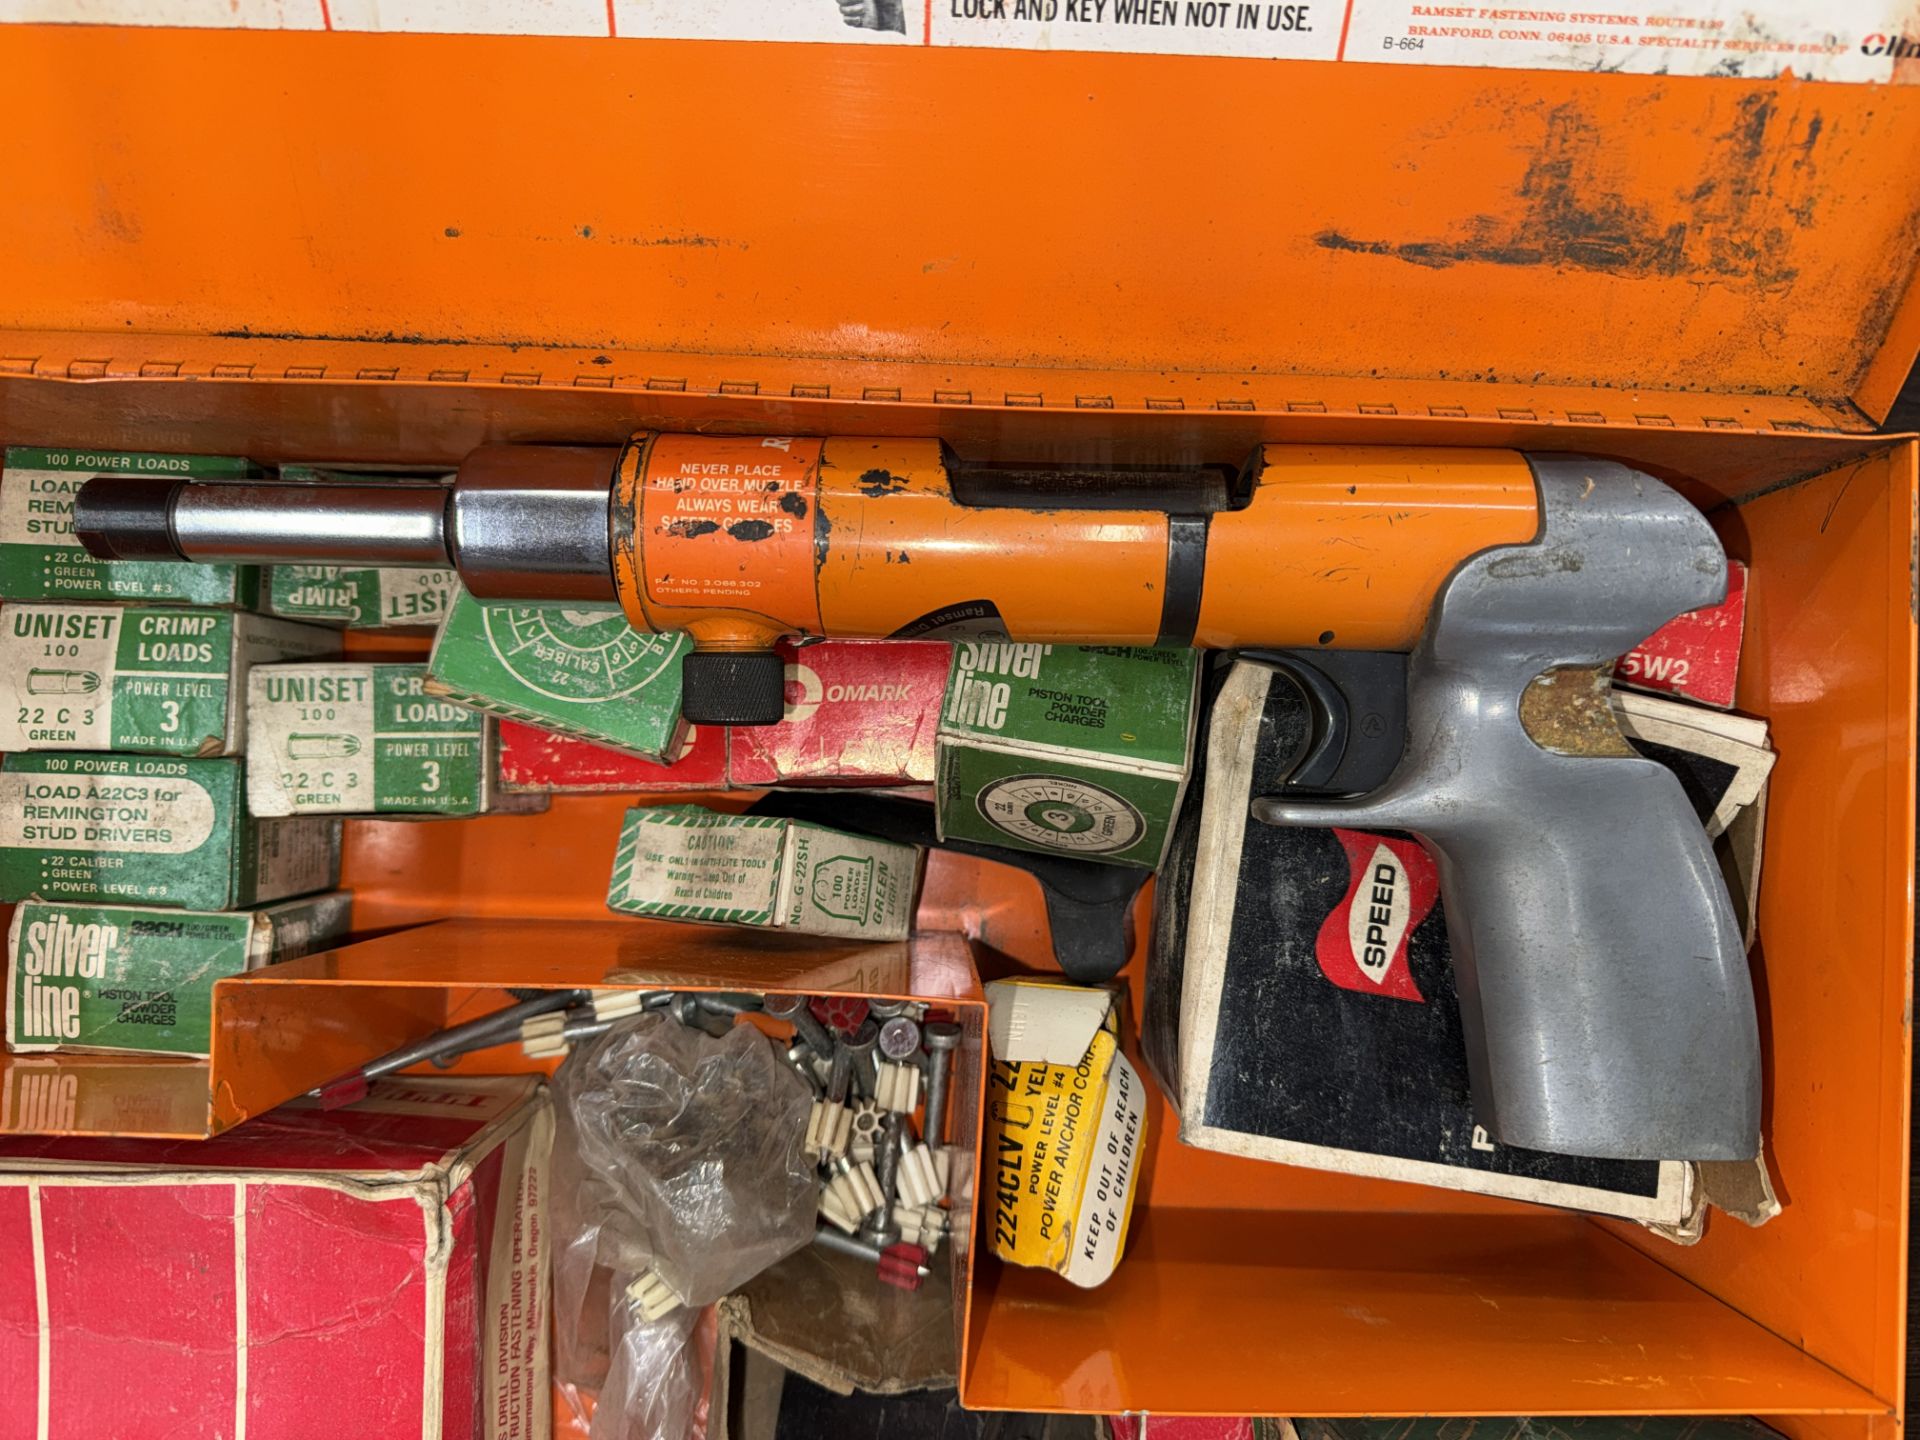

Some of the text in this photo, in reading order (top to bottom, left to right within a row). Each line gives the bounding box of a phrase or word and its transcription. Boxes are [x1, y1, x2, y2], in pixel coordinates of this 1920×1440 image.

[951, 0, 1313, 32] LOCK AND KEY WHEN NOT IN USE.
[1411, 6, 1474, 18] RAMSET
[1479, 9, 1565, 23] FASTENING
[1644, 16, 1695, 29] ROUTE
[1383, 37, 1425, 51] B-664
[1548, 32, 1591, 44] 06405
[1638, 36, 1718, 50] SPECIALTY
[46, 454, 190, 472] 100 POWER LOADS
[681, 463, 781, 477] NEVER PLACE
[700, 478, 739, 492] OVER
[676, 498, 779, 514] ALWAYS WEAR
[54, 552, 68, 563] 22
[54, 566, 96, 578] GREEN
[55, 578, 102, 591] POWER
[108, 581, 145, 593] LEVEL
[656, 586, 751, 596] OTHERS PENDING
[931, 606, 984, 625] Ramset
[14, 613, 116, 639] UNISET
[139, 616, 217, 637] CRIMP
[44, 644, 79, 657] 100
[138, 643, 213, 663] LOADS
[535, 643, 600, 674] CALIBER
[552, 670, 570, 685] 22
[126, 681, 214, 698] POWER LEVEL
[266, 677, 368, 702] UNISET
[826, 684, 913, 703] OMARK
[1028, 687, 1109, 709] PISTON TOOL
[947, 670, 1011, 730] line
[57, 708, 70, 724] C
[82, 709, 94, 725] 3
[160, 700, 180, 732] 3
[302, 708, 336, 721] 100
[396, 704, 469, 724] LOADS
[1051, 702, 1106, 718] POWDER
[1044, 711, 1105, 728] CHARGES
[29, 730, 76, 742] GREEN
[120, 735, 172, 747] MADE IN
[387, 742, 470, 757] POWER LEVEL
[45, 759, 188, 776] 100 POWER LOADS
[421, 760, 441, 792] 3
[322, 772, 334, 788] C
[346, 772, 358, 788] 3
[24, 784, 182, 802] LOAD A22C3 for
[296, 793, 341, 805] GREEN
[383, 796, 417, 806] MADE
[423, 796, 437, 806] IN
[23, 805, 148, 822] REMINGTON
[23, 825, 172, 844] STUD DRIVERS
[688, 835, 736, 851] CAUTION
[51, 856, 124, 869] 22 CALIBER
[645, 852, 664, 863] USE
[742, 858, 767, 869] TOOLS
[52, 868, 92, 880] GREEN
[738, 872, 747, 885] of
[52, 881, 97, 894] POWER
[103, 884, 140, 896] LEVEL
[833, 875, 844, 898] 100
[844, 867, 854, 910] POWER
[851, 870, 861, 910] LOADS
[860, 863, 870, 904] CALIBER
[674, 886, 694, 898] Reach
[703, 887, 733, 901] Children
[873, 861, 889, 925] GREEN
[886, 875, 898, 916] LIGHT
[790, 901, 803, 925] No.
[1363, 863, 1397, 968] SPEED
[25, 914, 118, 979] silver
[98, 989, 140, 1001] PISTON
[23, 975, 80, 1039] line
[122, 1002, 176, 1015] POWDER
[117, 1013, 176, 1027] CHARGES
[1025, 1065, 1048, 1097] YEL
[1029, 1071, 1066, 1195] POWER LEVEL #4
[1040, 1170, 1064, 1241] POWER
[1054, 1091, 1084, 1169] ANCHOR
[1084, 1067, 1130, 1261] KEEP OUT OF REACH
[1105, 1111, 1138, 1233] OF CHILDREN
[528, 1167, 537, 1207] 97222
[994, 1134, 1023, 1251] 224CLV
[527, 1213, 539, 1257] Oregon
[510, 1270, 523, 1359] FASTENING
[498, 1303, 509, 1427] DRILL DIVISION
